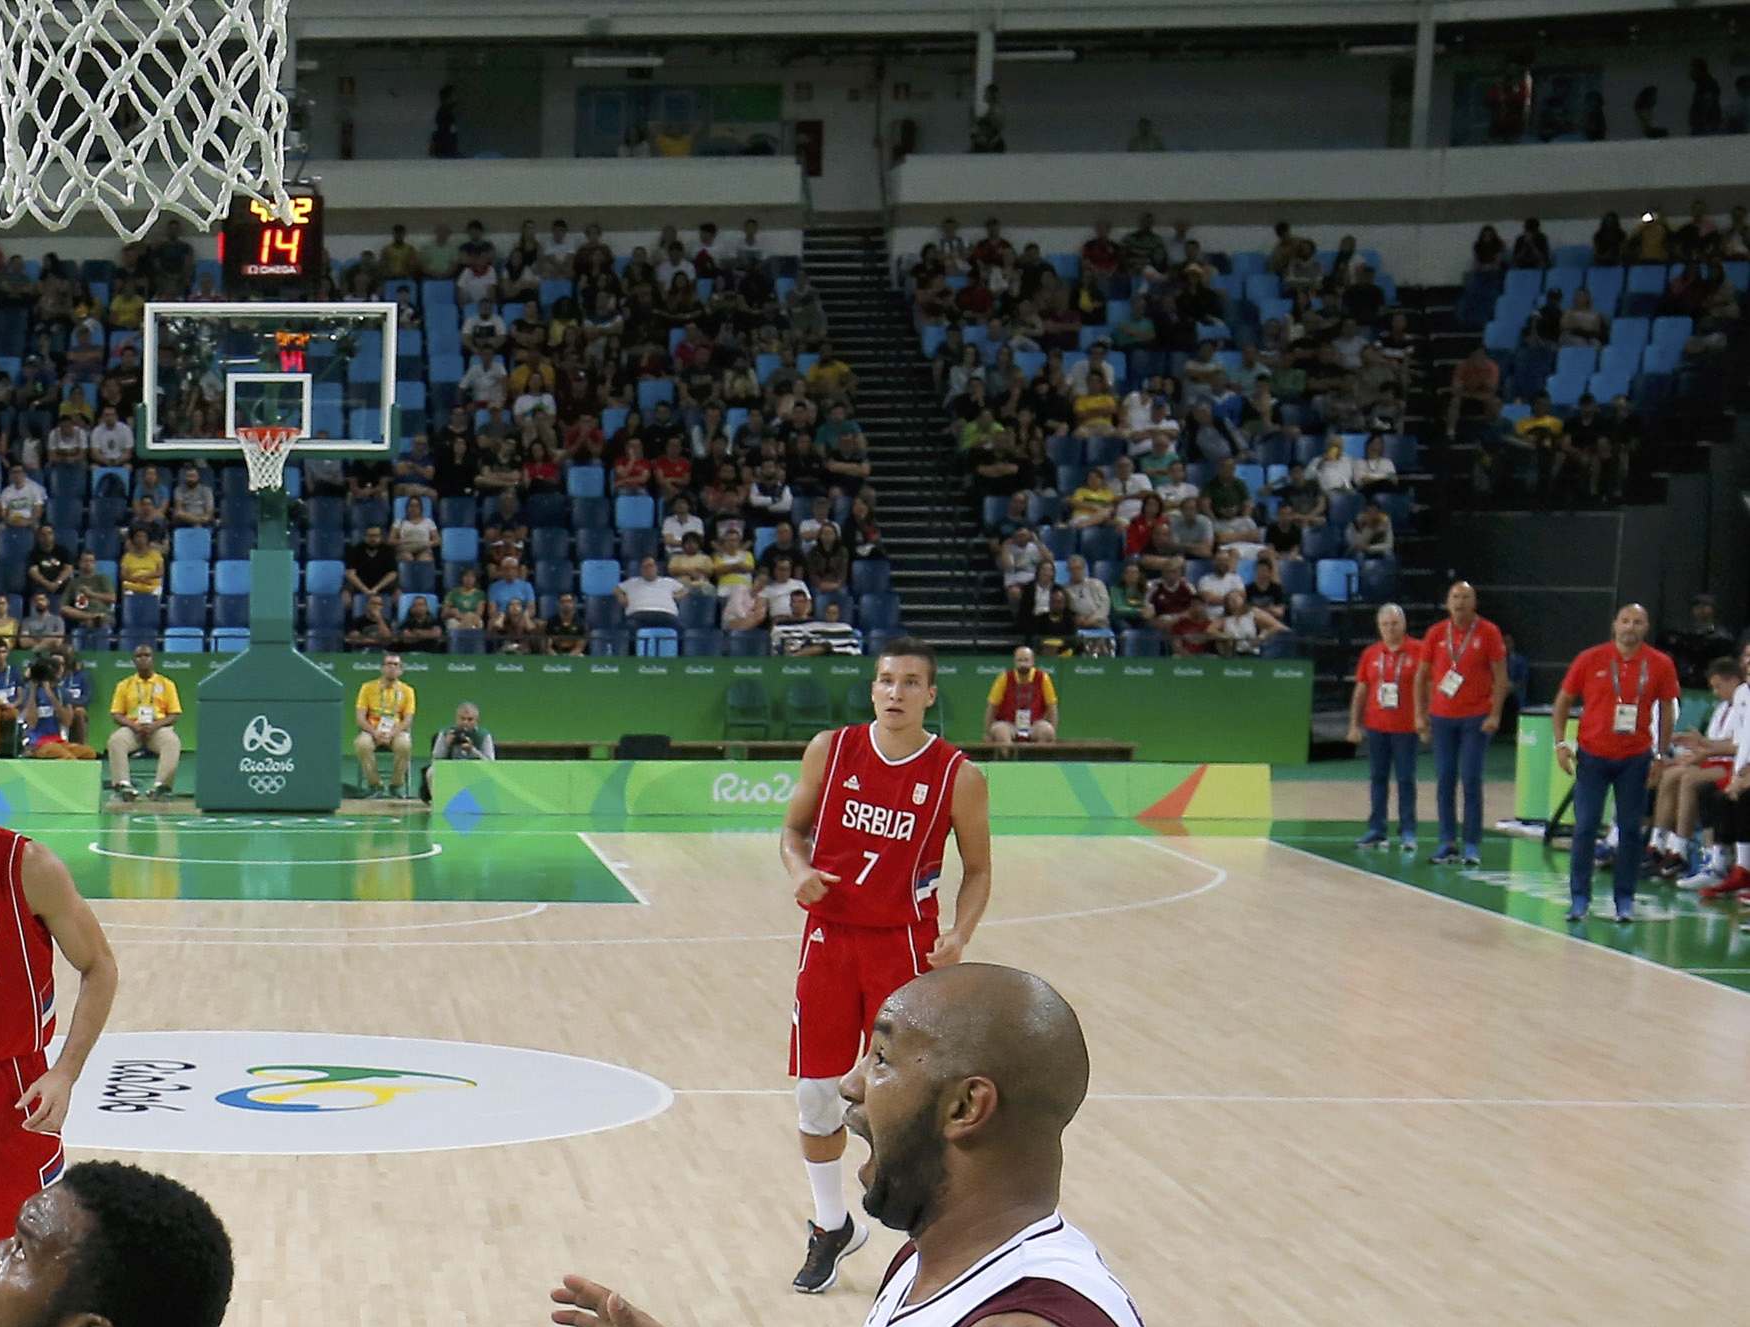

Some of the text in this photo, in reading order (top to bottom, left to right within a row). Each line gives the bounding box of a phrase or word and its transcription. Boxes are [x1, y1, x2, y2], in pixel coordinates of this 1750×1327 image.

[261, 229, 301, 264] 14
[239, 757, 295, 772] Rio2016
[712, 772, 797, 804] Rio2
[855, 851, 880, 885] 7
